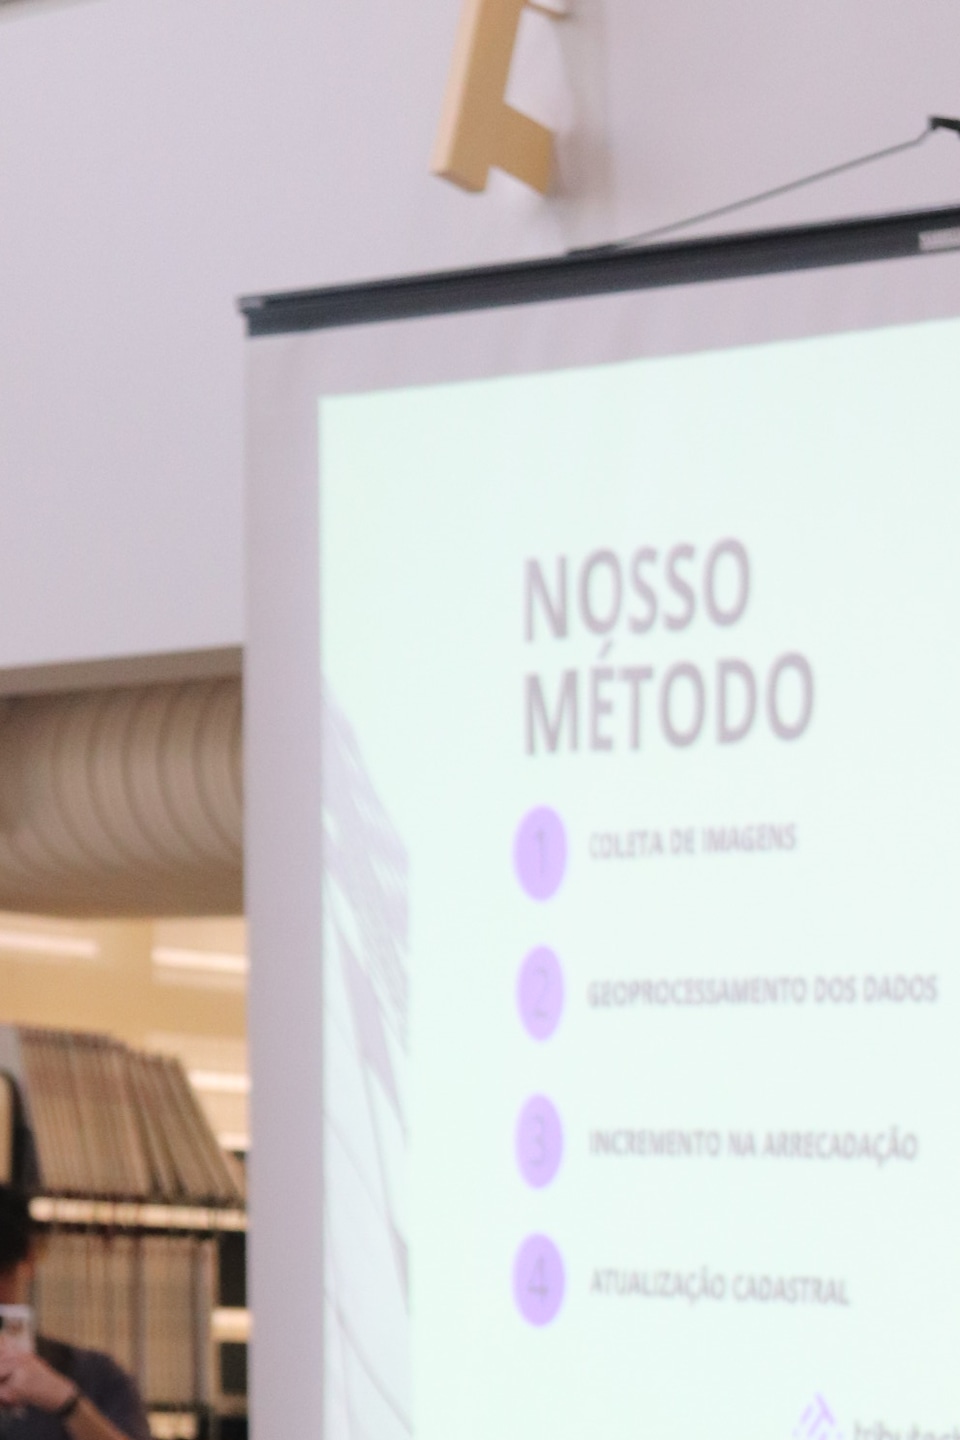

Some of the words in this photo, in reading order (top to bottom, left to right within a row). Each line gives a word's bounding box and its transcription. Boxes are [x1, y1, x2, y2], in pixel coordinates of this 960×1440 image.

[524, 537, 752, 644] NOSSO
[524, 638, 816, 757] MÉTODO
[589, 829, 665, 859] COLETA
[670, 827, 696, 855] DE
[701, 823, 798, 854] IMAGENS
[587, 975, 808, 1009] GEOPROCESSAMENTO
[814, 974, 858, 1003] DOS
[863, 974, 940, 1003] DADOS
[589, 1129, 722, 1158] INCREMENTO
[728, 1130, 759, 1158] NA
[761, 1125, 919, 1167] ARRECADAÇÃO
[527, 1255, 550, 1304] 4
[590, 1266, 727, 1305] ATUALIZAÇÃO
[731, 1274, 851, 1307] CADASTRAL
